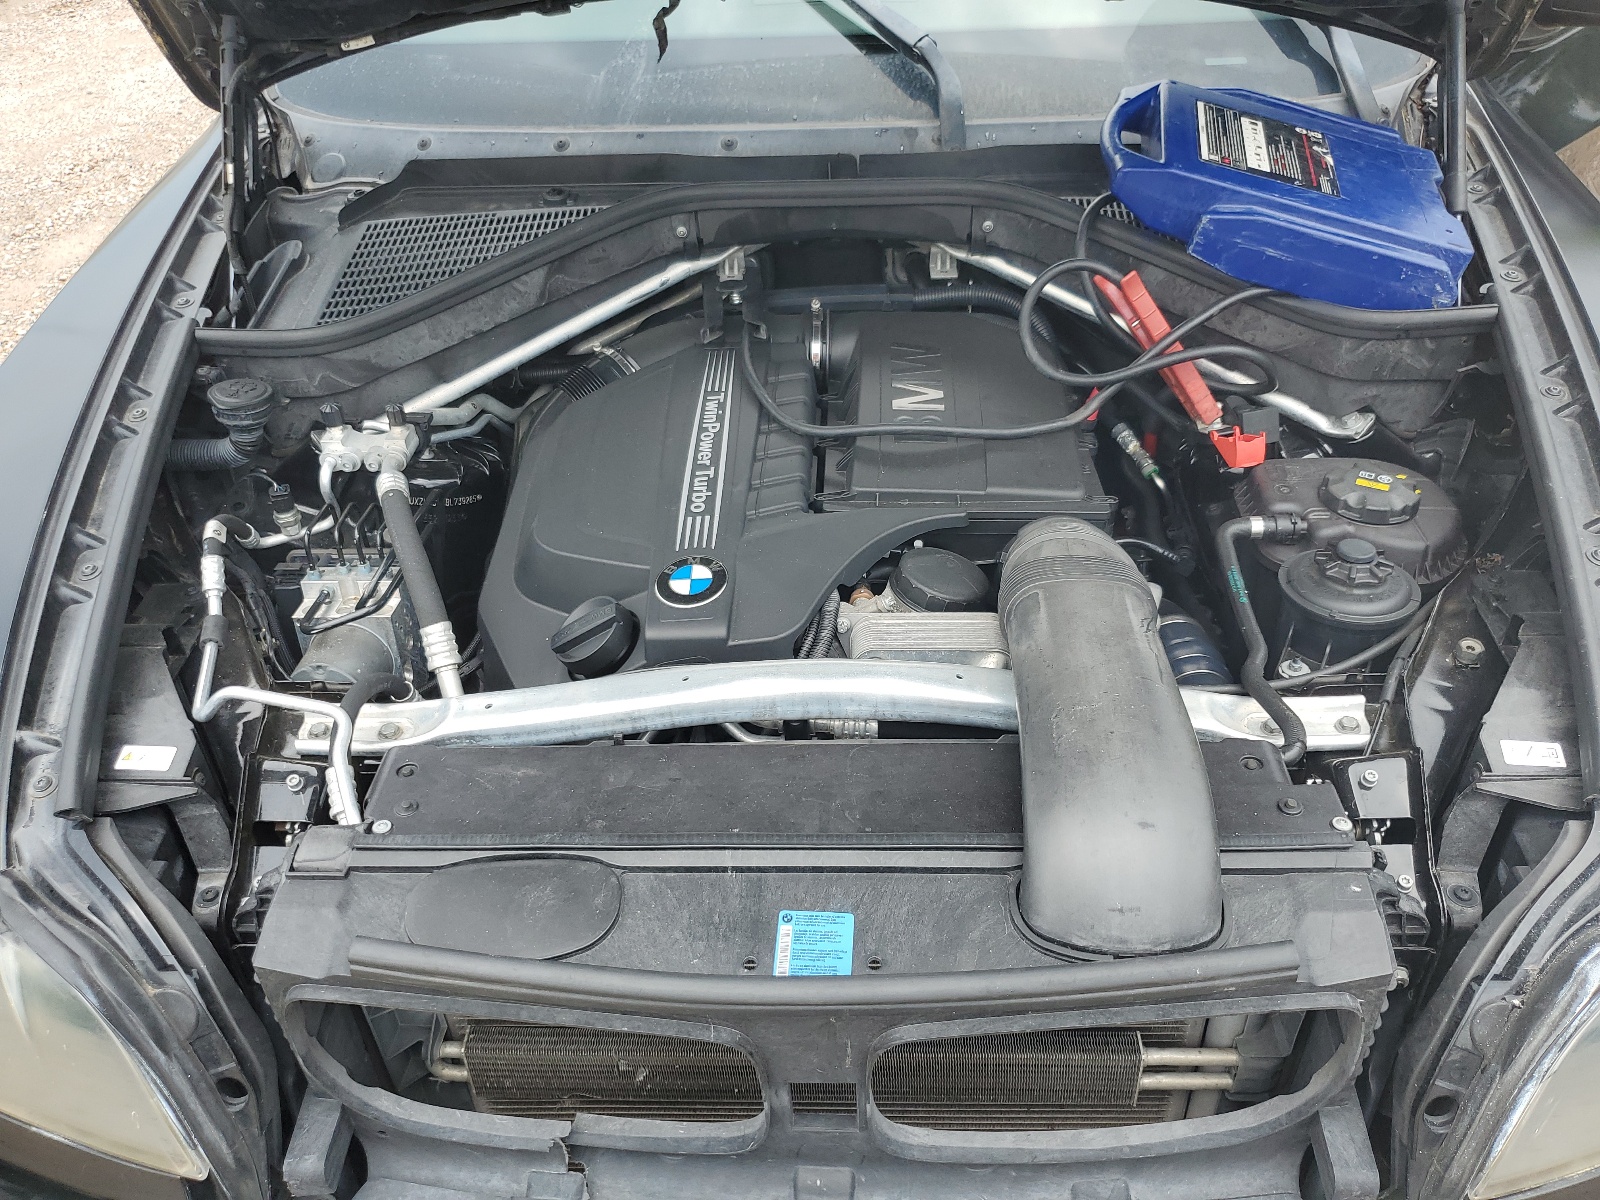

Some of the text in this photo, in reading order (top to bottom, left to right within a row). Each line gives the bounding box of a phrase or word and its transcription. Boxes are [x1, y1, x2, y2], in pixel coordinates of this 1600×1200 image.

[690, 392, 724, 513] TwinPower Turbo
[663, 557, 723, 575] BMW
